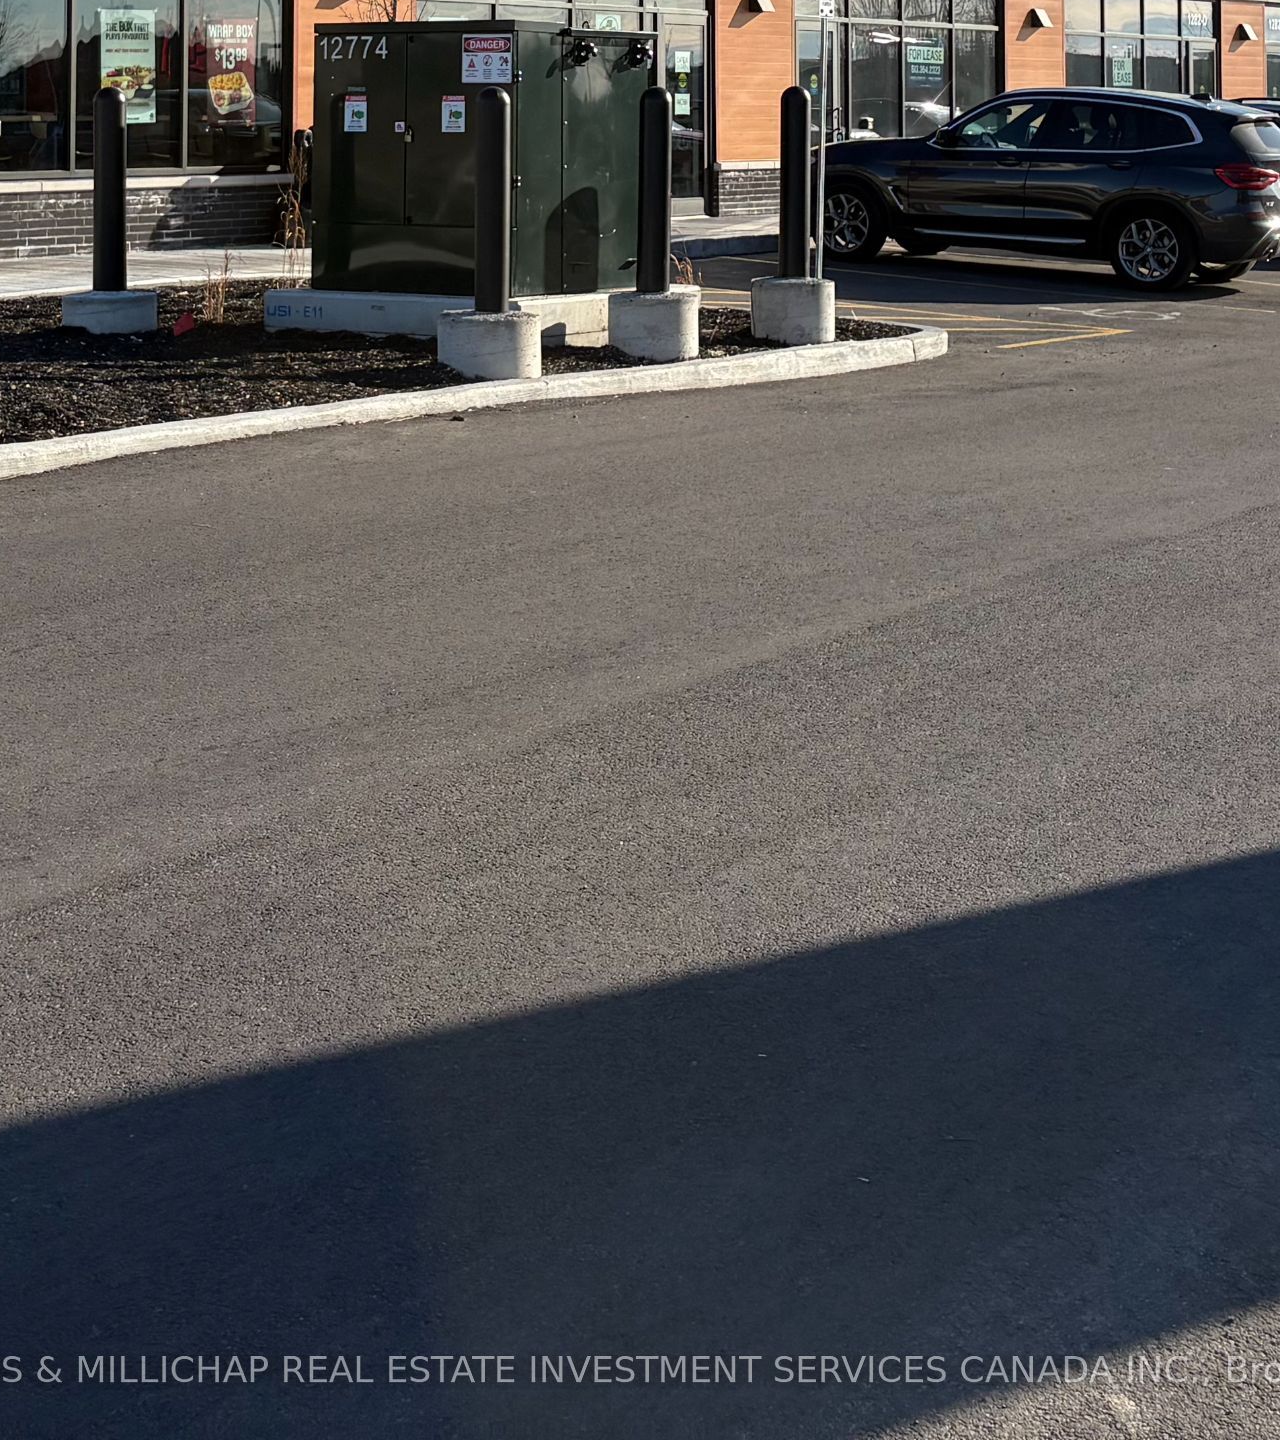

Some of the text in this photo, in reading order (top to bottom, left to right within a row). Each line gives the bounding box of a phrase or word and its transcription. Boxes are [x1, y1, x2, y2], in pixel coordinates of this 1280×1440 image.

[208, 24, 255, 38] WRAP BOX
[320, 35, 389, 61] 12774
[470, 40, 505, 49] DANGER
[908, 48, 943, 62] FOR LEASE
[1113, 60, 1126, 72] FOR
[1113, 72, 1132, 84] LEASE
